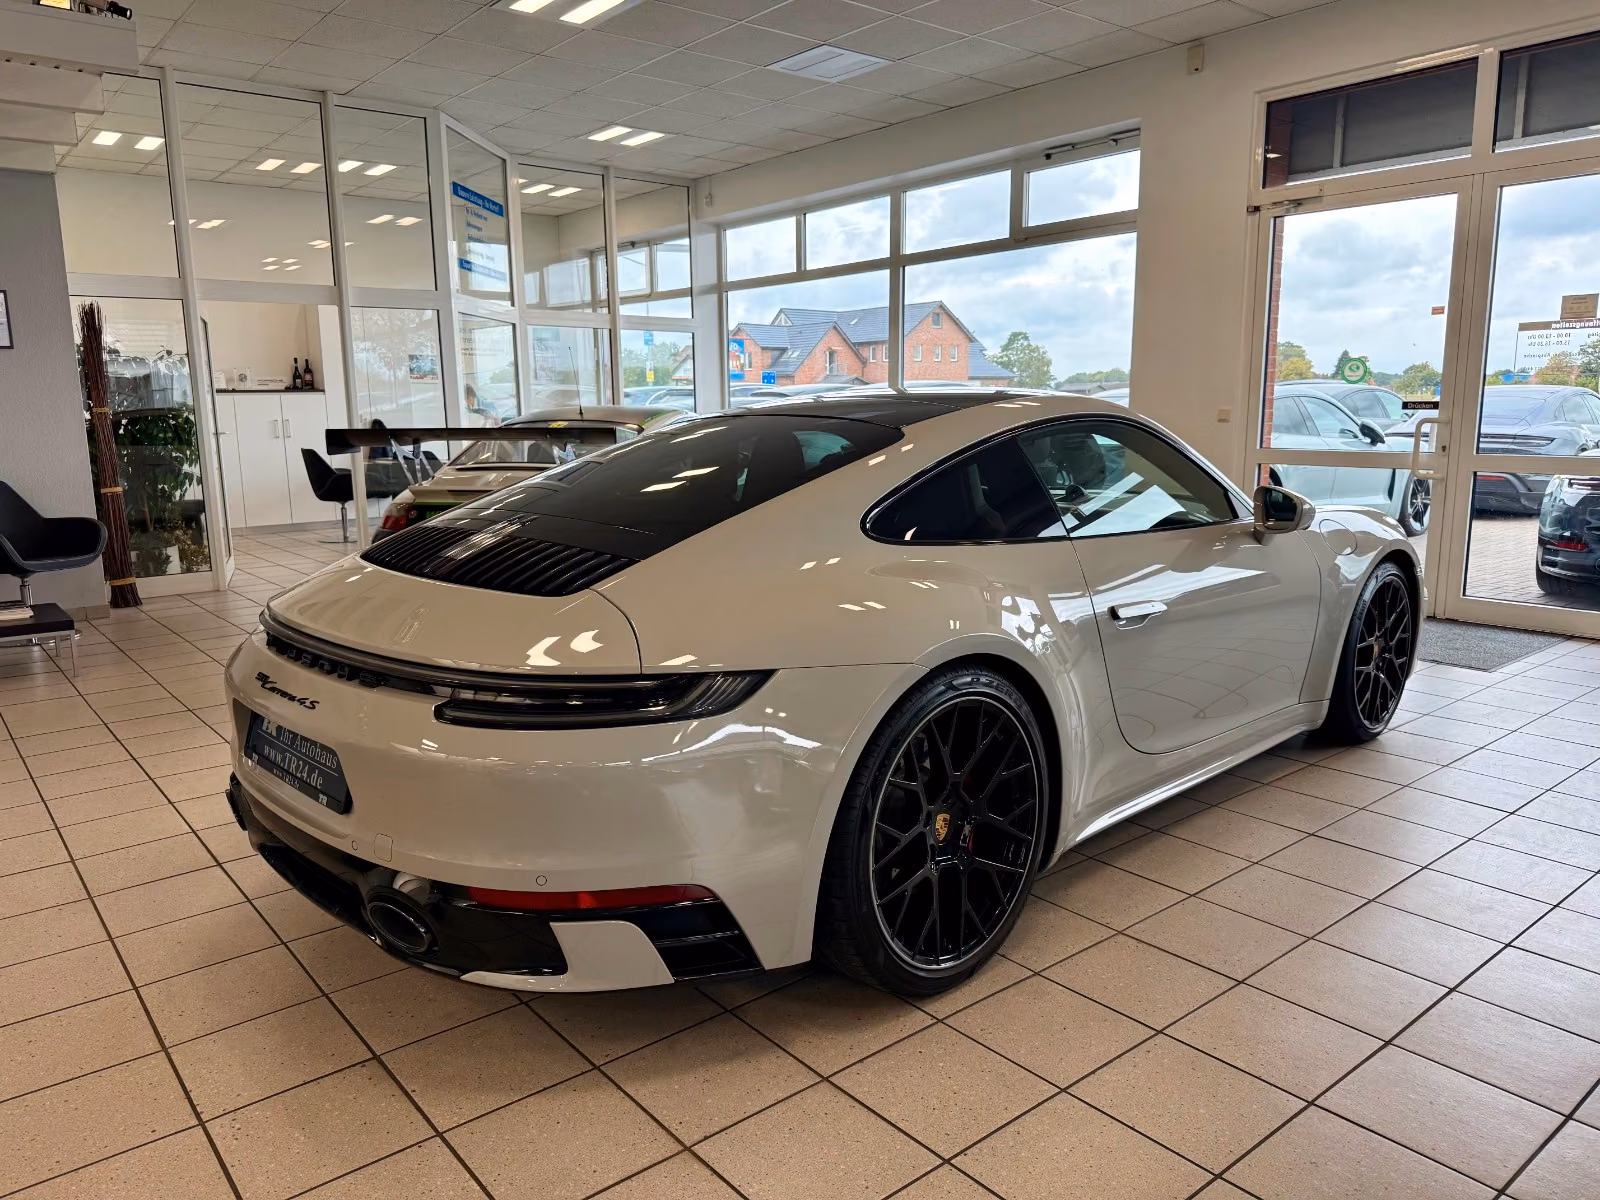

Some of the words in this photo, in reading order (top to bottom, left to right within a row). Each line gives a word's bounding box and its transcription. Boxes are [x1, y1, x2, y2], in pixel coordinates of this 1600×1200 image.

[263, 743, 323, 789] www.TR24.de
[280, 727, 293, 746] Ihr
[293, 735, 338, 769] Autohaus
